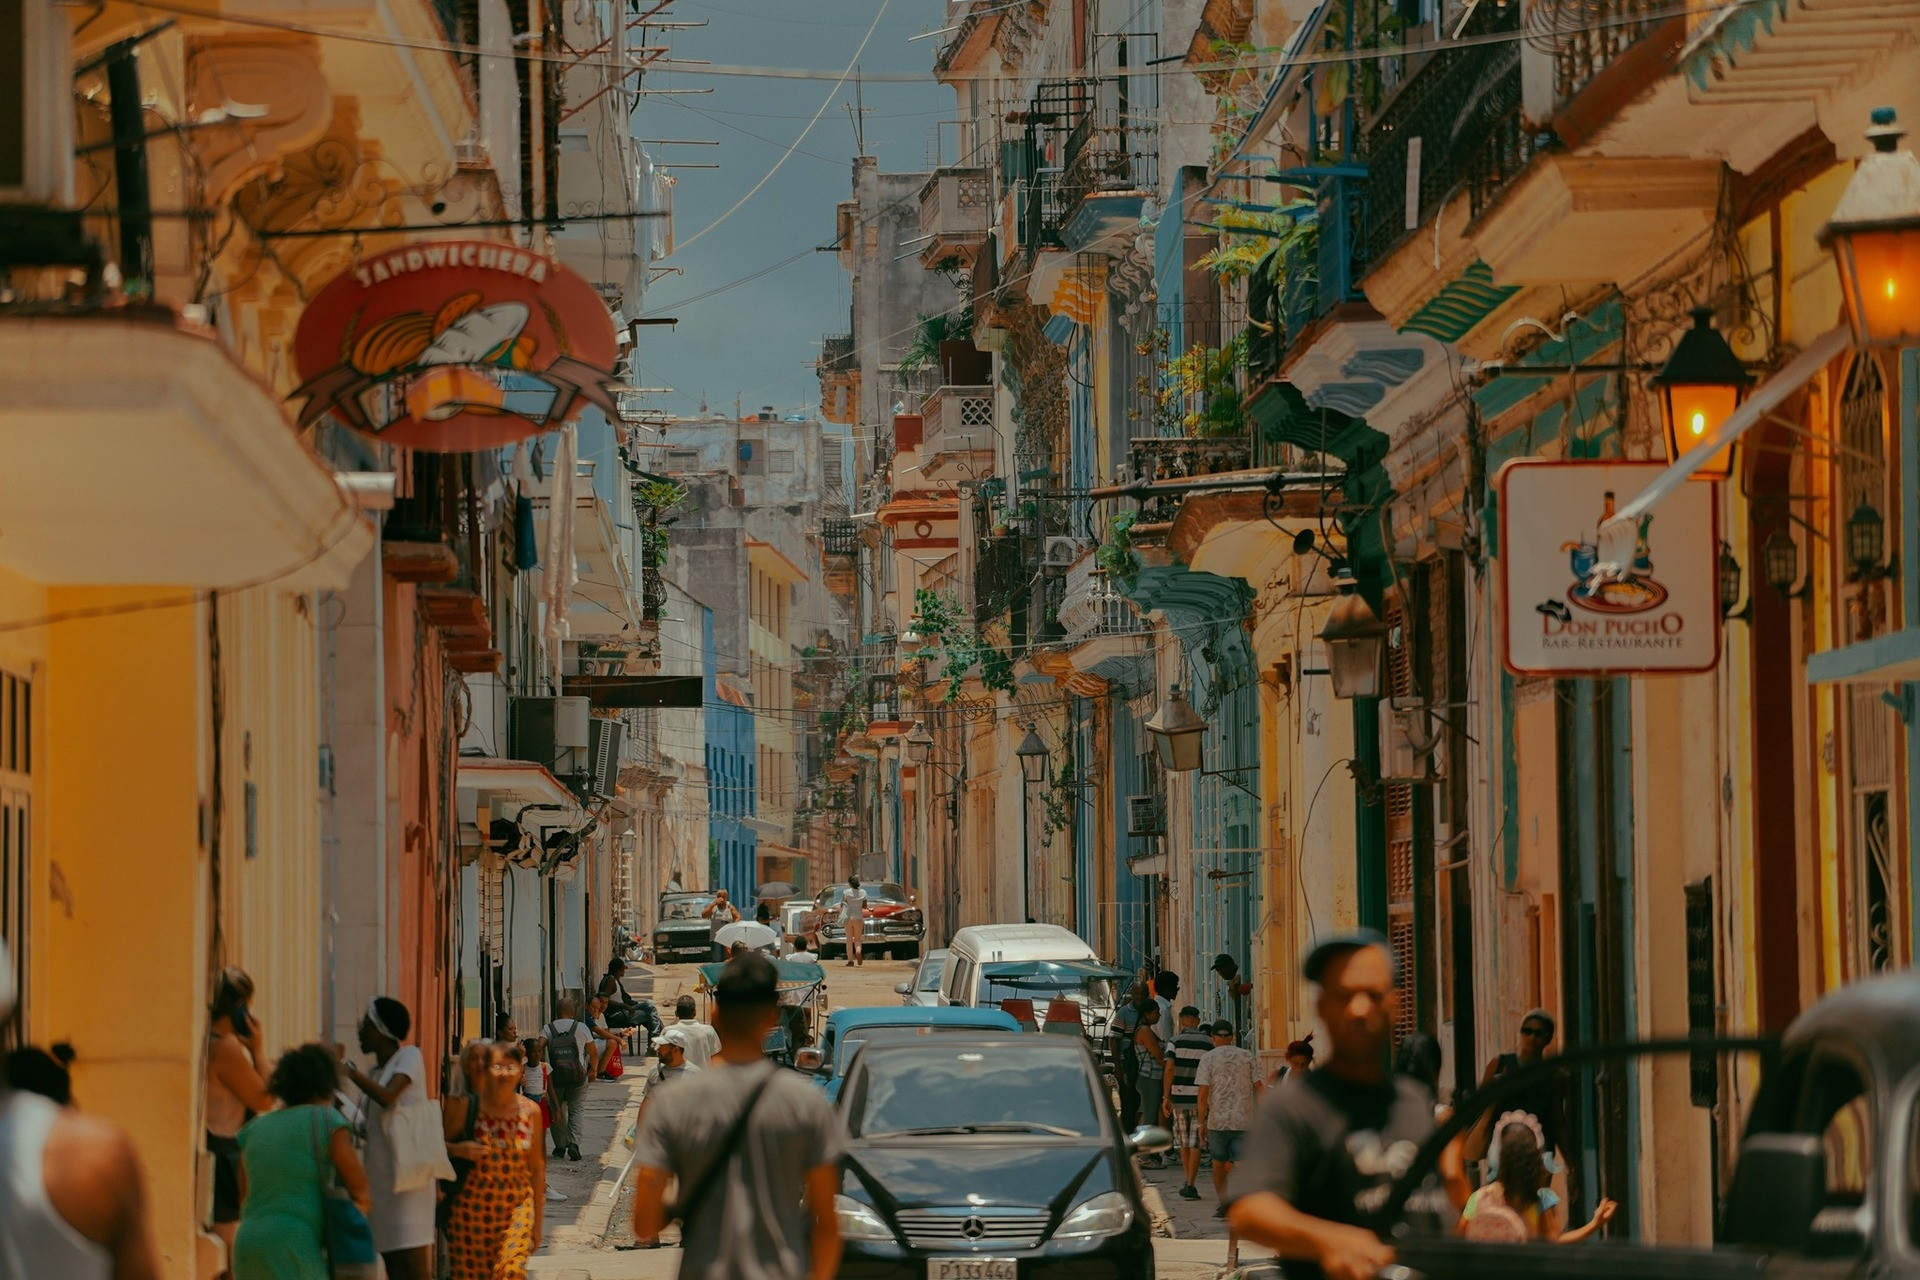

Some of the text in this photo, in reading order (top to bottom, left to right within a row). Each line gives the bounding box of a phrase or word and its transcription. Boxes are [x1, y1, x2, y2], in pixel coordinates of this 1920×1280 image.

[357, 245, 547, 288] SANDWICHERA
[1542, 611, 1683, 637] DON PUCHO
